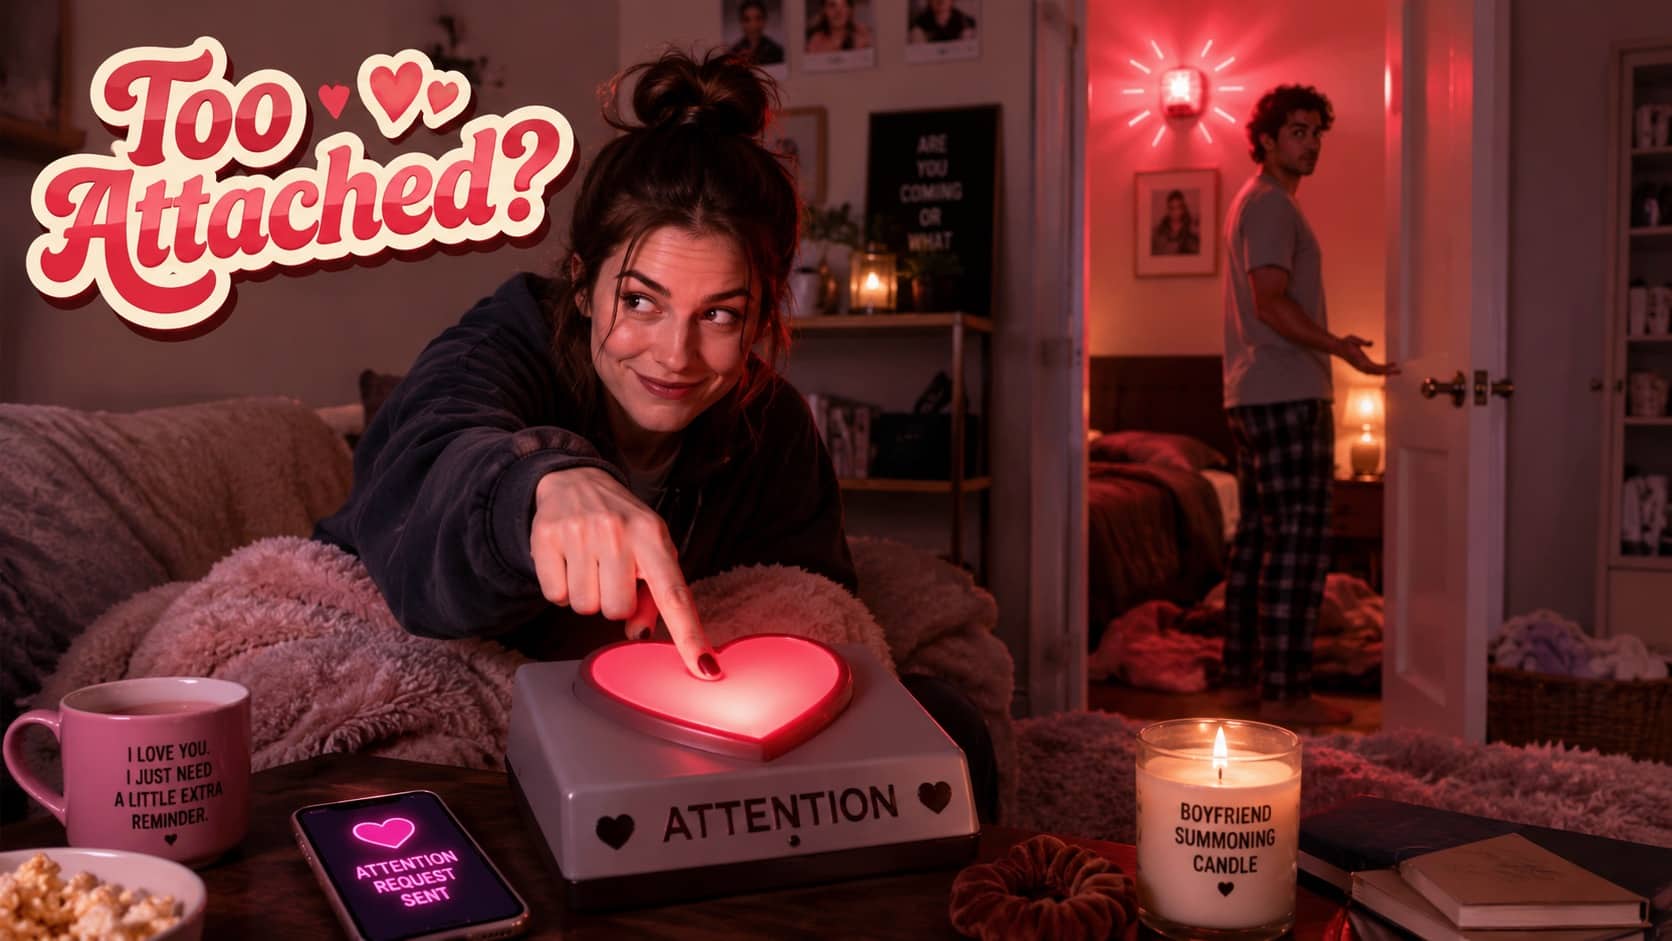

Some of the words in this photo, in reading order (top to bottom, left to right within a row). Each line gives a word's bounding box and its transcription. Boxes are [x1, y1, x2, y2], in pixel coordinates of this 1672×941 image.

[917, 133, 947, 153] ARE
[917, 159, 948, 178] YOU
[900, 182, 963, 203] COMING
[919, 207, 941, 227] OR
[908, 231, 953, 251] WHAT
[128, 746, 132, 762] I
[137, 744, 174, 762] LOVE
[179, 740, 210, 759] YOU.
[127, 769, 131, 785] I
[136, 767, 172, 785] JUST
[176, 761, 212, 782] NEED
[114, 791, 125, 807] A
[128, 789, 177, 808] LITTLE
[181, 781, 223, 804] EXTRA
[131, 807, 208, 830] REMINDER.
[663, 784, 899, 843] ATTENTION
[1181, 802, 1272, 824] BOYFRIEND
[1175, 826, 1276, 849] SUMMONING
[356, 850, 458, 880] ATTENTION
[1193, 854, 1258, 874] CANDLE
[373, 867, 456, 894] REQUEST
[400, 886, 450, 907] SENT
